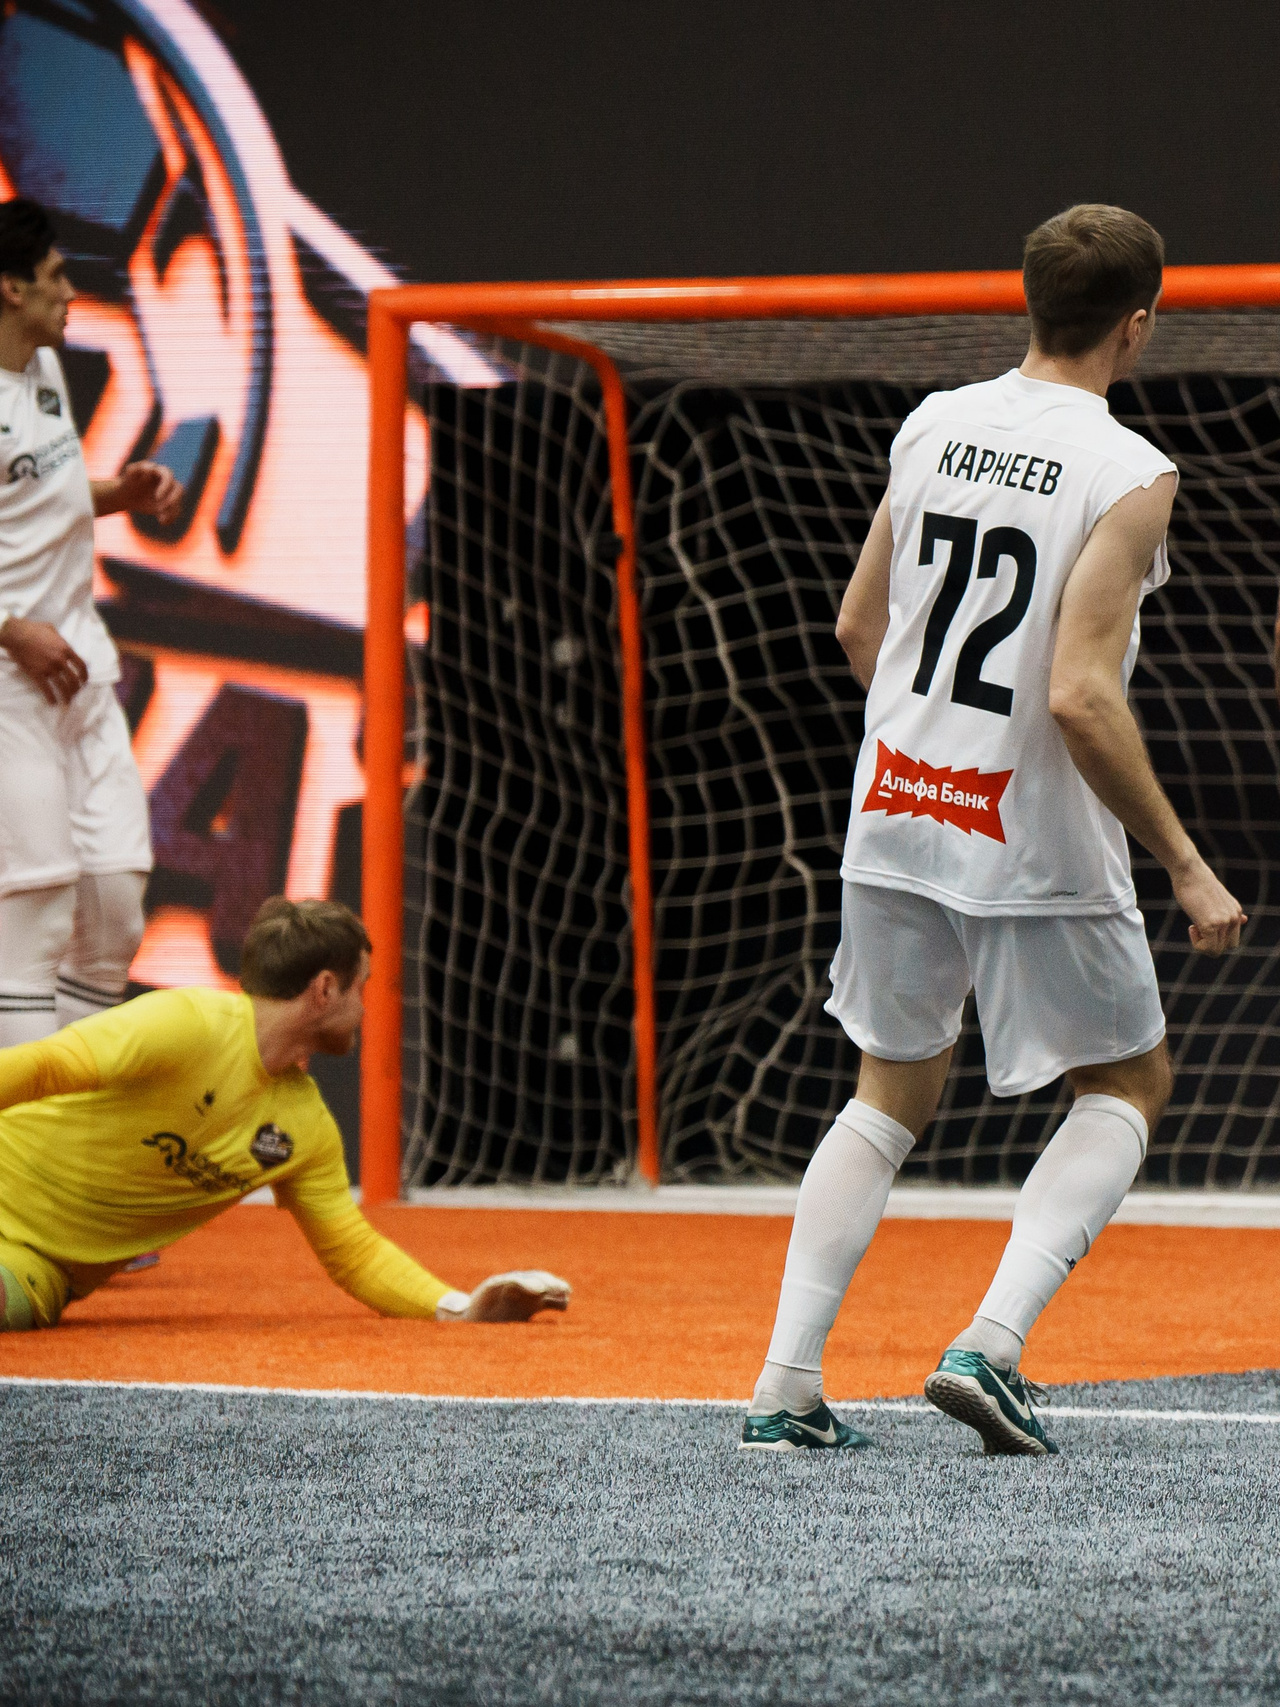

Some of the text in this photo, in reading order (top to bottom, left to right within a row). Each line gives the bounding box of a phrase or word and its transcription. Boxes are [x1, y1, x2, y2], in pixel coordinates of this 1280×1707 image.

[938, 441, 1062, 495] КАРНЕЕВ
[912, 512, 1036, 717] 72
[879, 768, 990, 811] Альфа Банк
